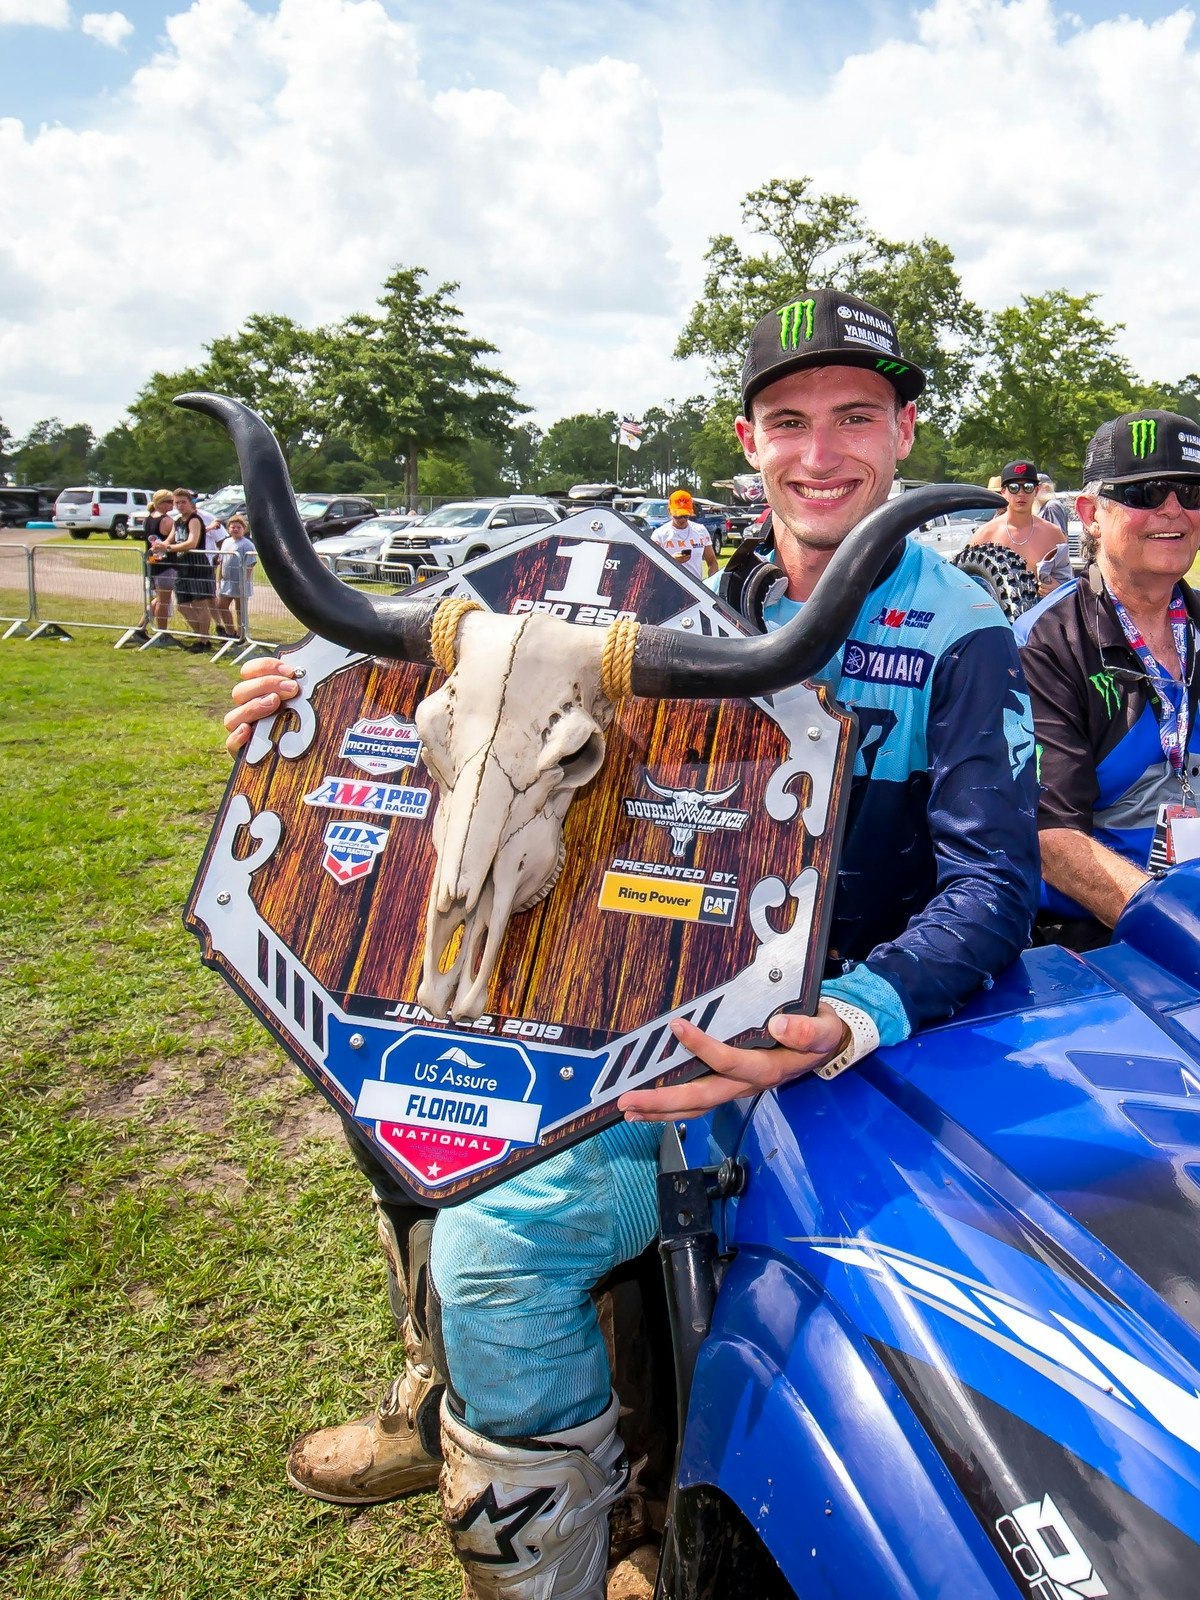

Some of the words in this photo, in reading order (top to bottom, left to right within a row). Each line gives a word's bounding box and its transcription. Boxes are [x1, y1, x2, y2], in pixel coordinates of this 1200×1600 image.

[851, 309, 894, 337] YAMAHA
[907, 609, 936, 622] PRO
[361, 725, 395, 738] LUCAS
[394, 728, 411, 739] OIL
[346, 741, 418, 756] MOTOCROSS
[312, 781, 386, 810] AMA
[387, 789, 428, 807] PRO
[384, 804, 424, 815] RACING
[625, 800, 675, 821] DOUBLE
[700, 805, 749, 829] RANCH
[654, 819, 697, 830] MOTOCROSS
[697, 824, 716, 832] PARK
[332, 845, 347, 853] PRO
[346, 847, 372, 857] RACING
[611, 859, 706, 880] PRESENTED
[710, 872, 738, 885] BY:
[618, 886, 648, 903] Ring
[649, 890, 691, 907] Power
[703, 895, 732, 915] CAT
[384, 1003, 452, 1025] JUN
[502, 1019, 563, 1041] 2019
[413, 1062, 438, 1082] US
[440, 1066, 498, 1092] Assure
[405, 1093, 489, 1128] FLORIDA
[391, 1126, 492, 1152] NATIONAL
